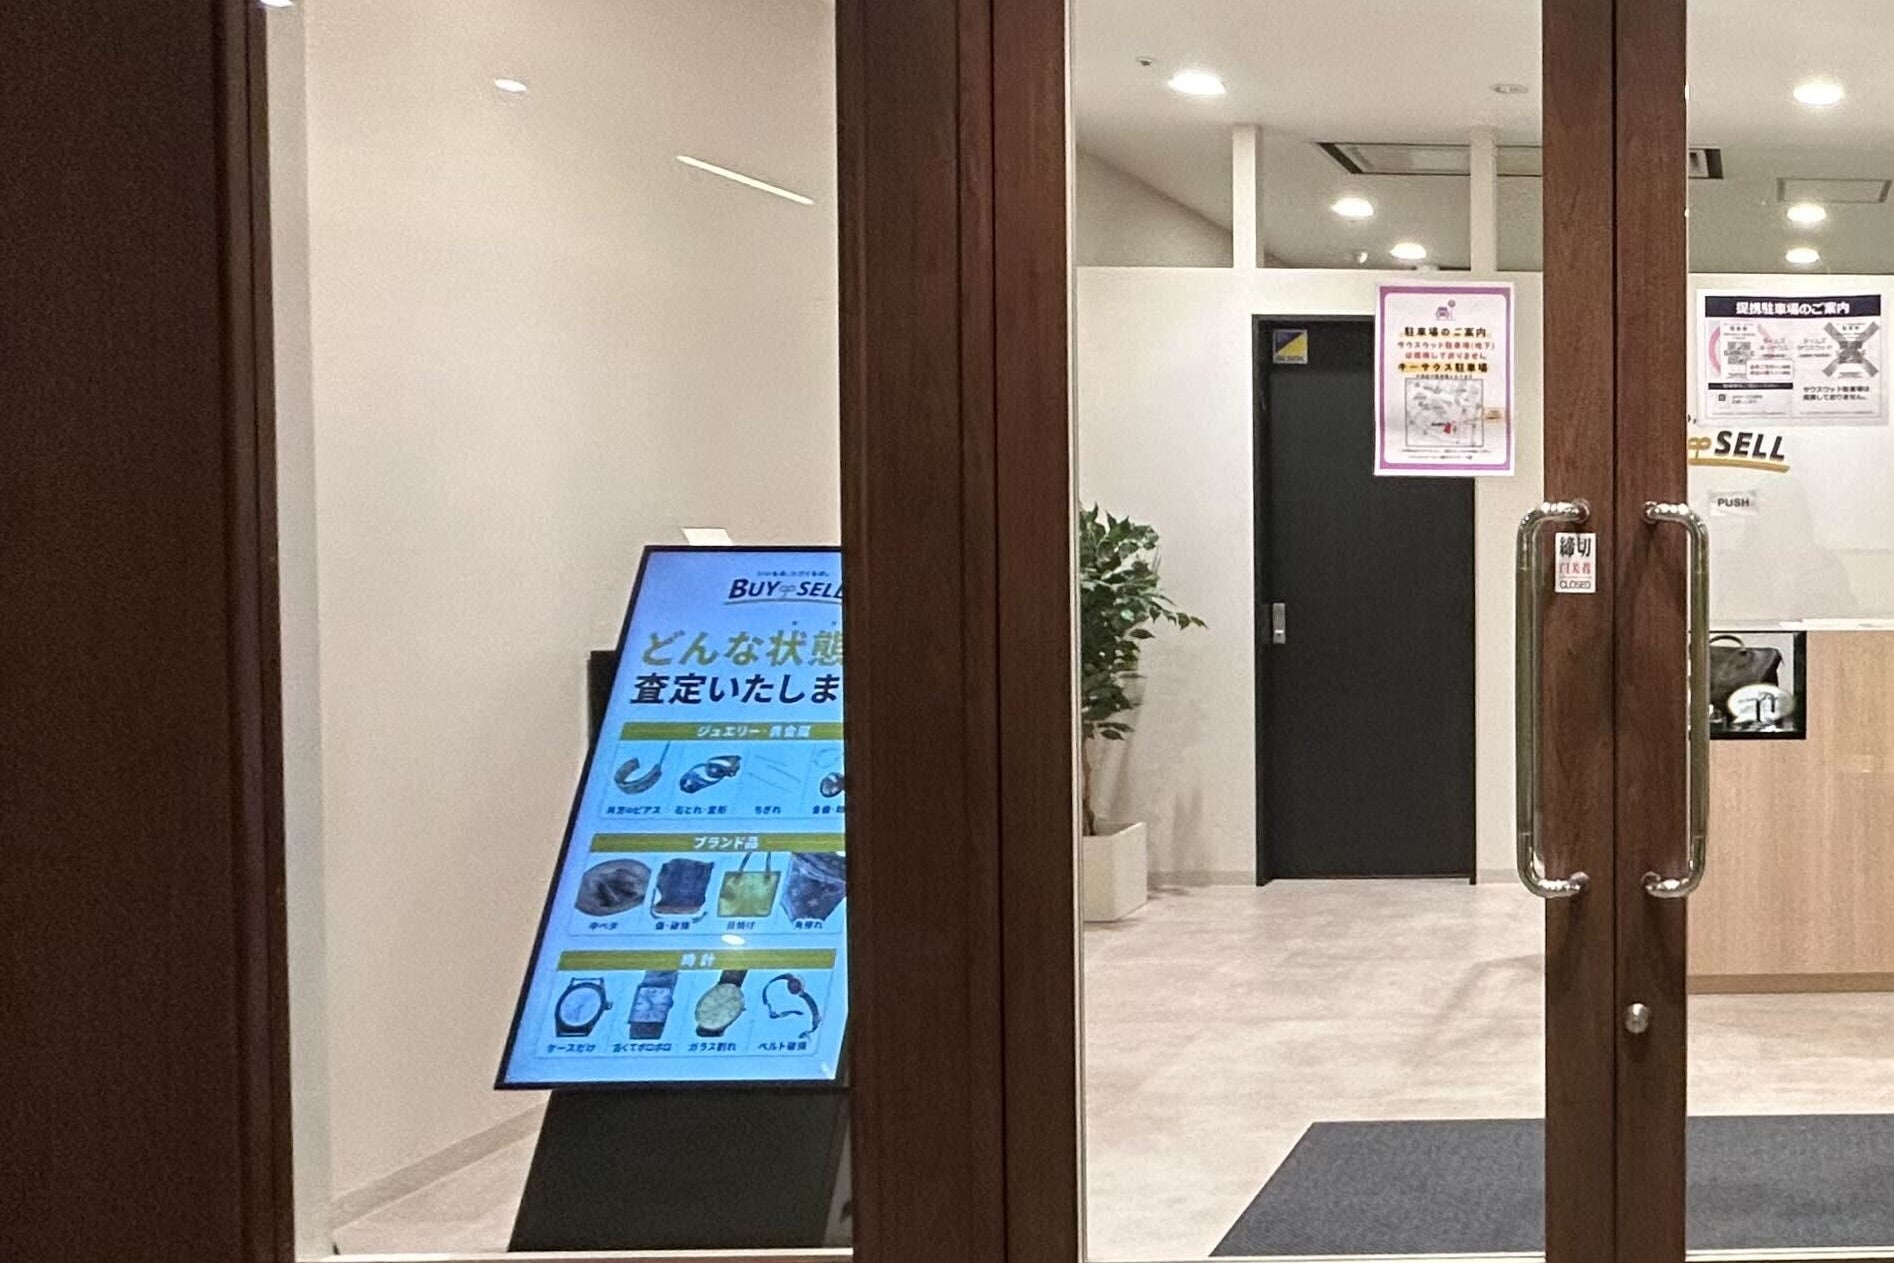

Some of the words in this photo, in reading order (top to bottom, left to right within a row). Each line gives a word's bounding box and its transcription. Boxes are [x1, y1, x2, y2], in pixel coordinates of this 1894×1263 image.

[1714, 430, 1785, 461] SELL
[1717, 498, 1750, 507] PUSH
[728, 578, 773, 599] BUY
[630, 673, 840, 705] 査定いたしま
[694, 836, 759, 850] ブランド品
